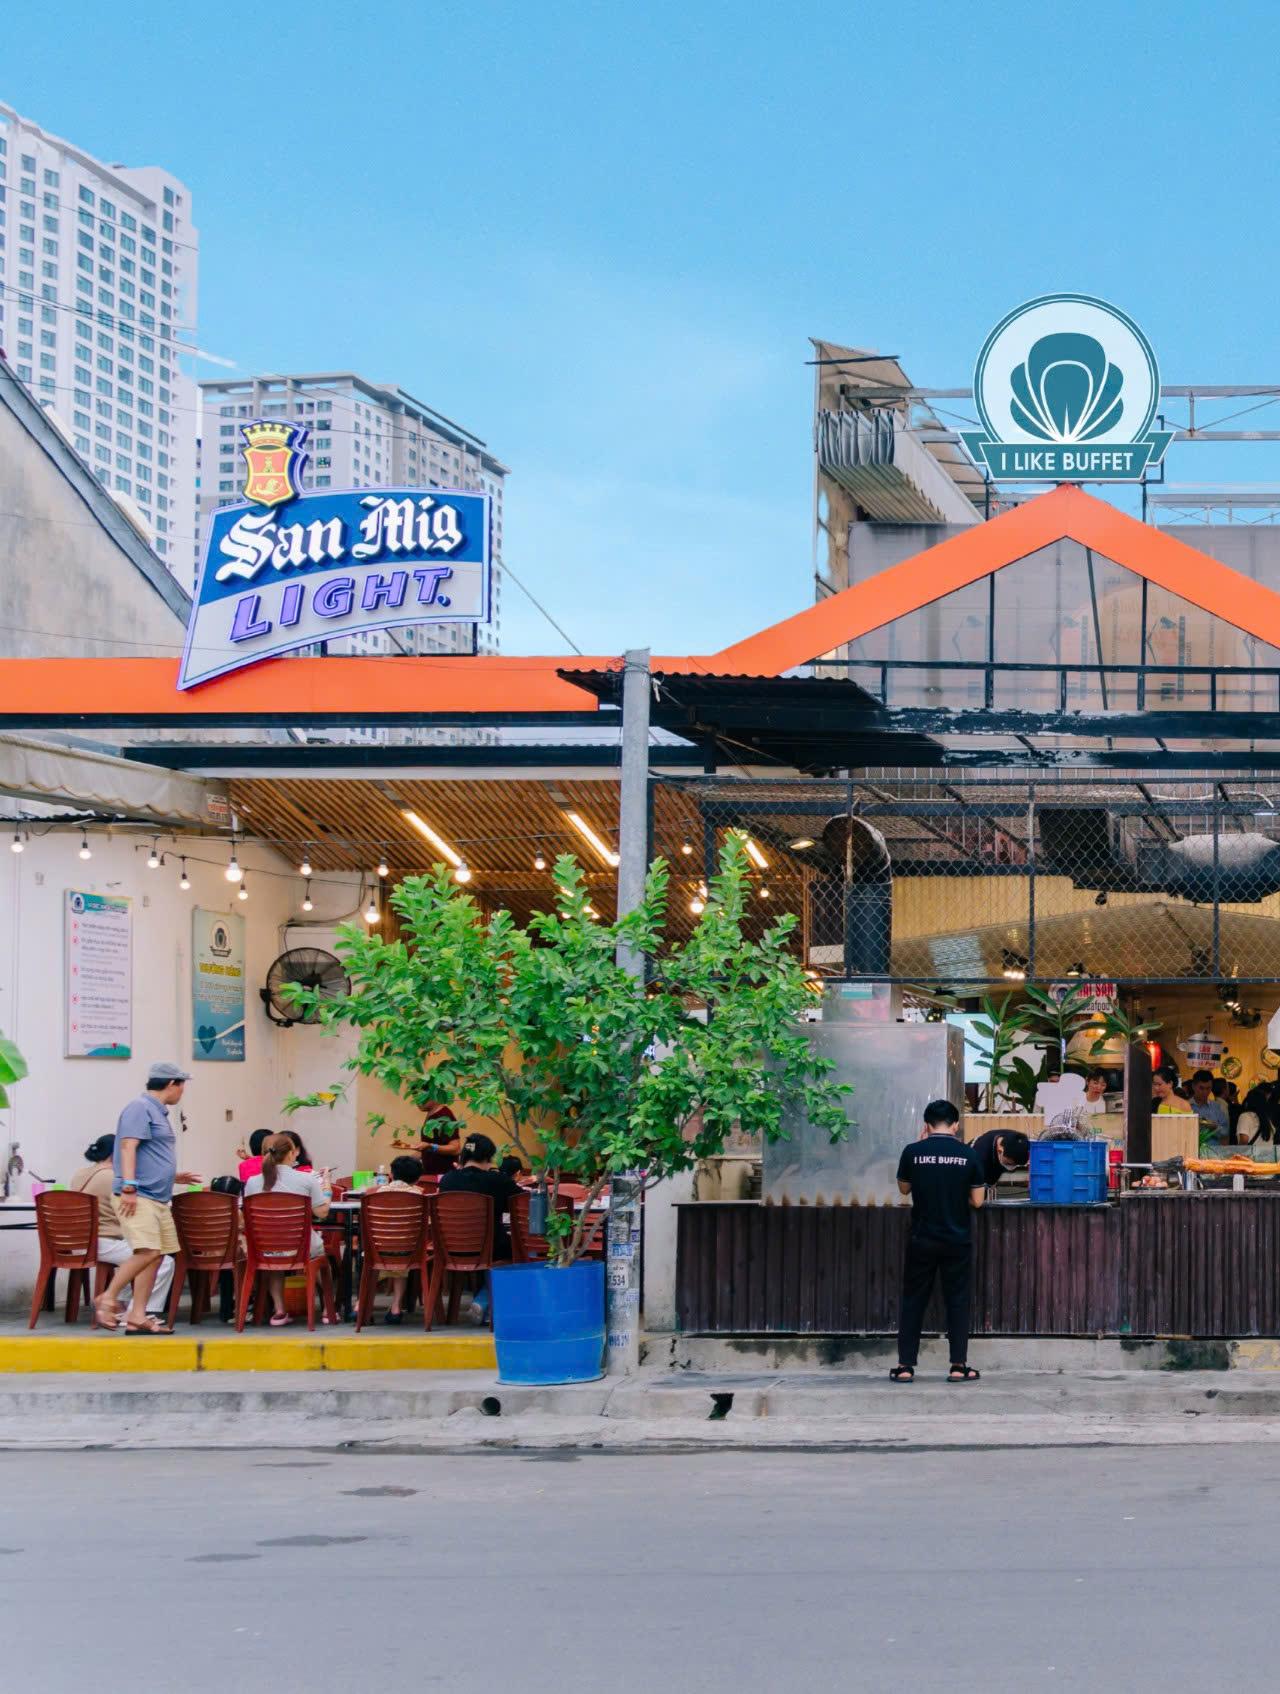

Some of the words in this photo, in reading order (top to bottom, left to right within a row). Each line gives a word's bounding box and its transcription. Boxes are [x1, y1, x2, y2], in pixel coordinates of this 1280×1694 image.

[1001, 452, 1007, 471] I
[1014, 452, 1056, 471] LIKE
[1062, 452, 1130, 471] BUFFET
[215, 510, 345, 582] San
[351, 495, 463, 559] Mig
[919, 1156, 937, 1164] LIKE
[938, 1156, 968, 1166] BUFFET
